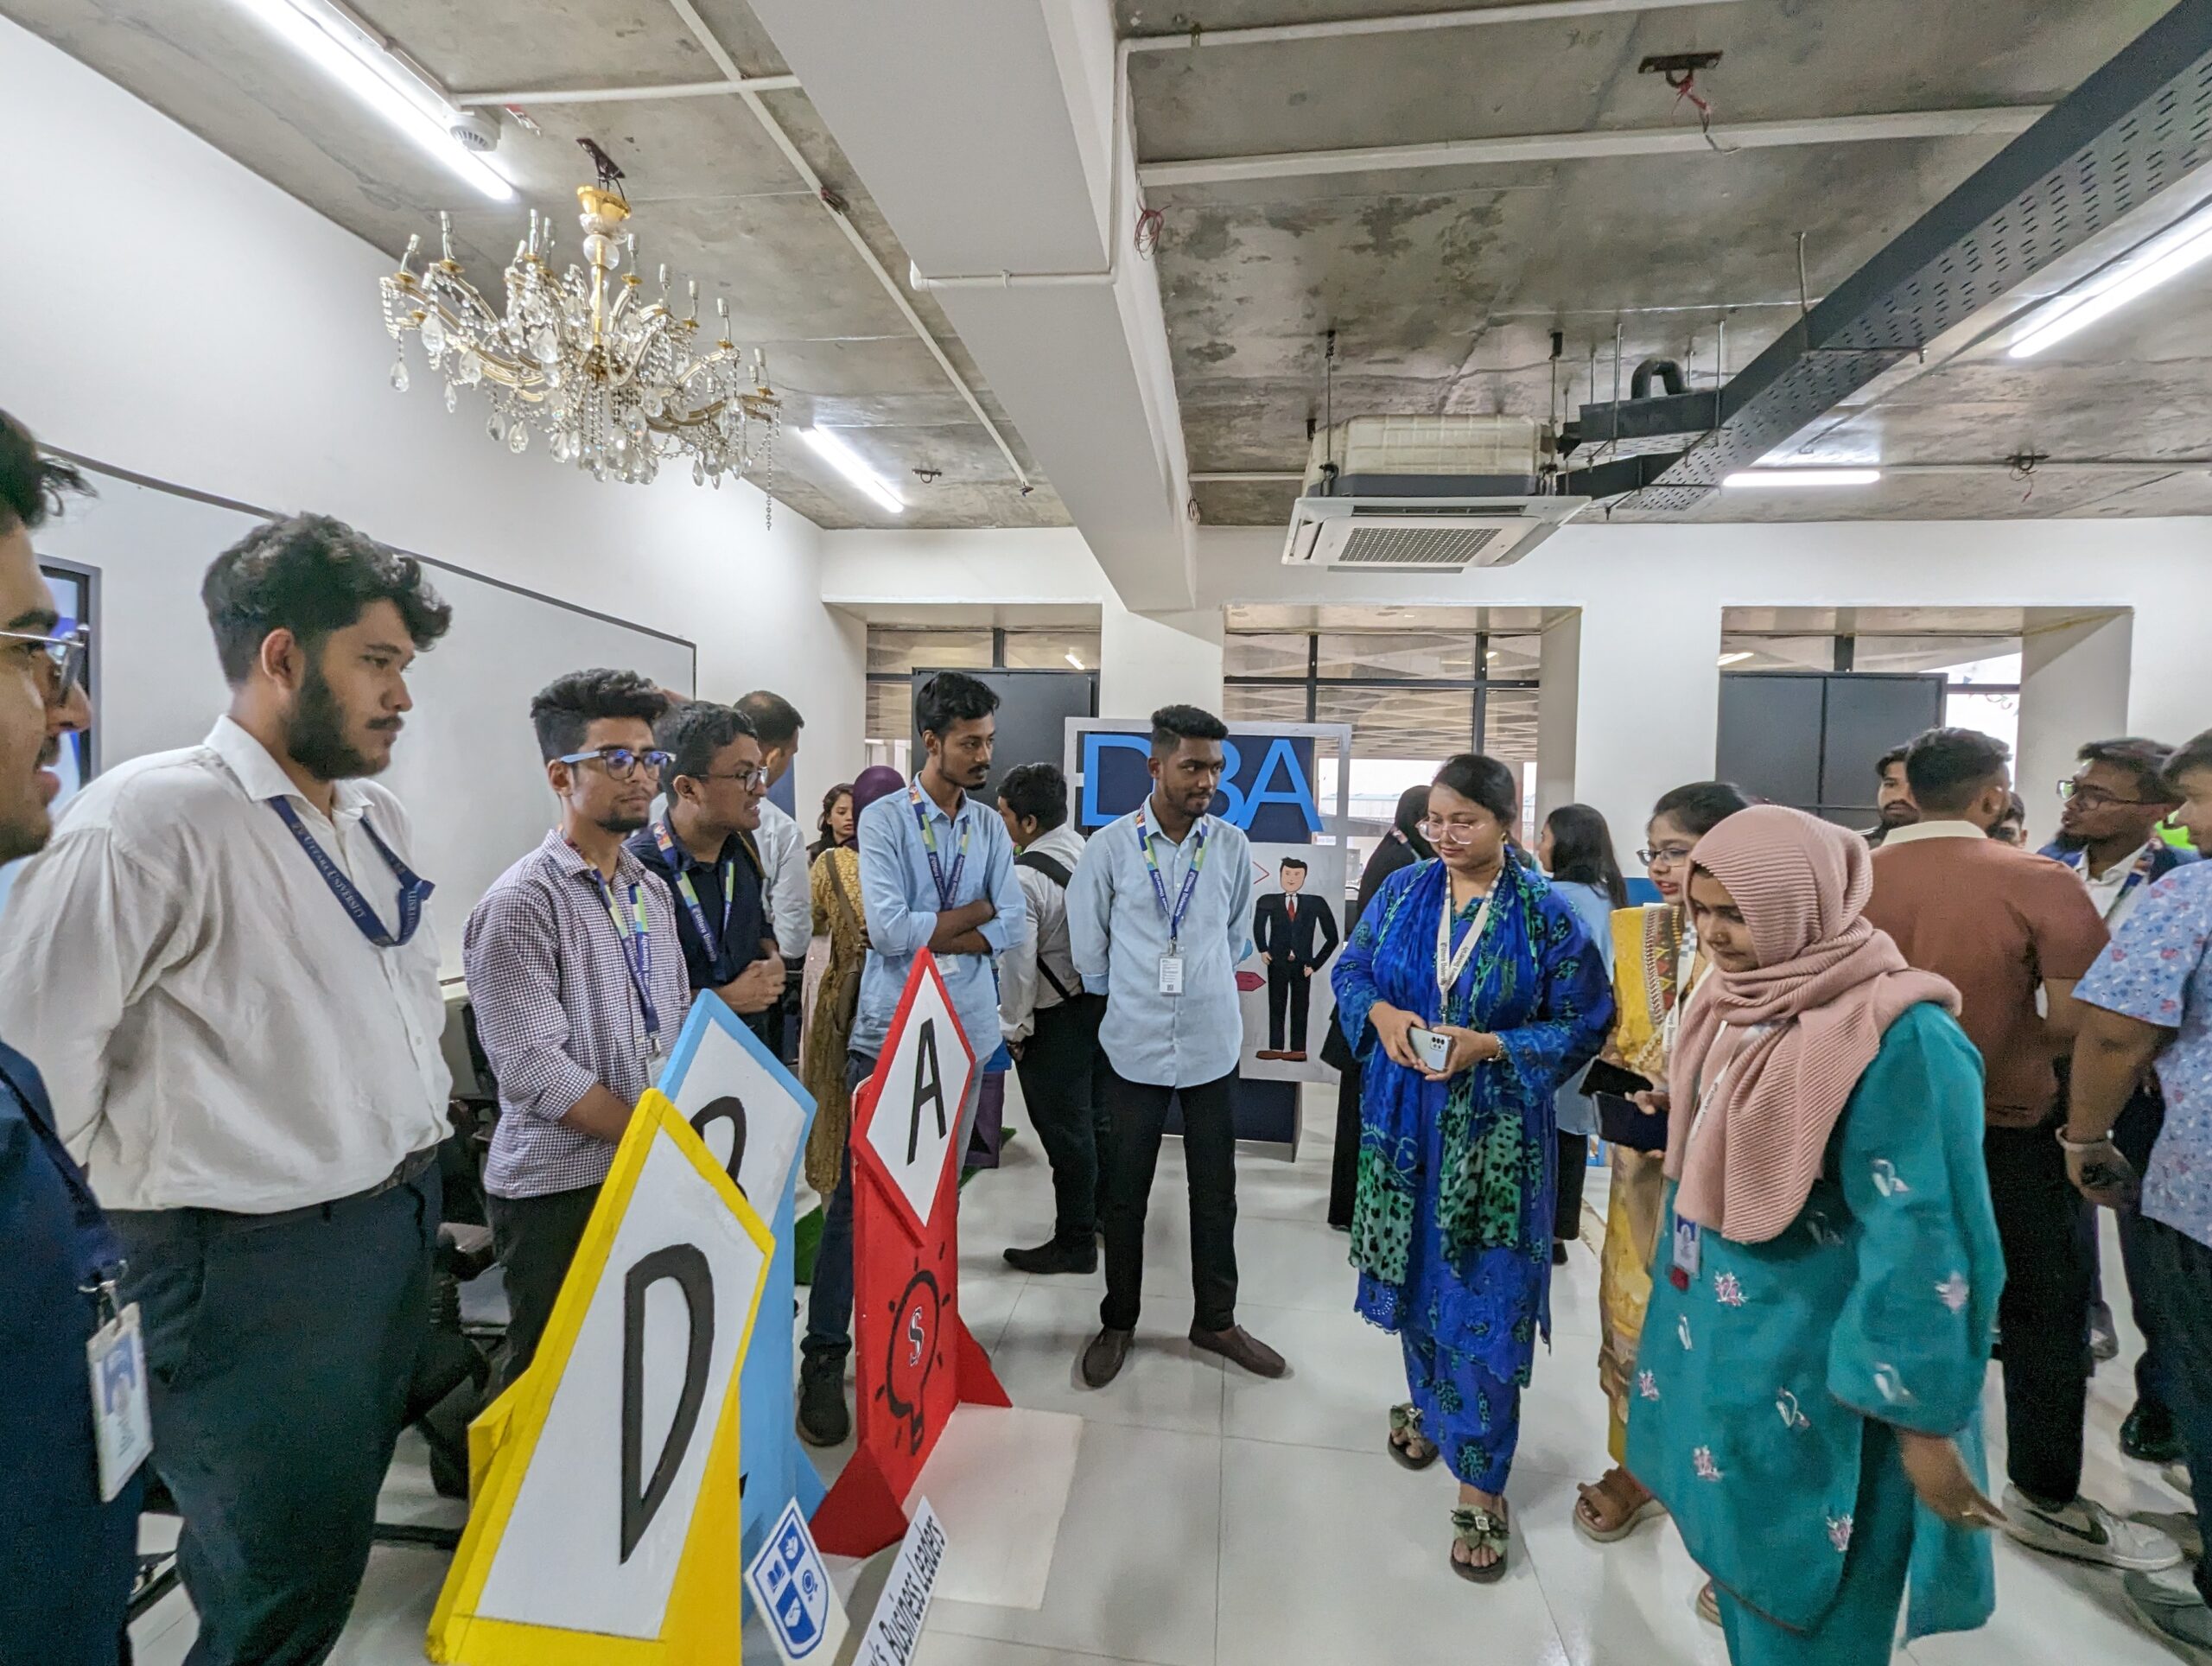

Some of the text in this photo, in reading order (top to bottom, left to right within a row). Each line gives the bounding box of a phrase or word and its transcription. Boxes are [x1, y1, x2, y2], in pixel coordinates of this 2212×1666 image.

[906, 1017, 947, 1166] A
[620, 1243, 715, 1565] D
[879, 1571, 925, 1666] Business
[905, 1515, 946, 1593] Leaders
